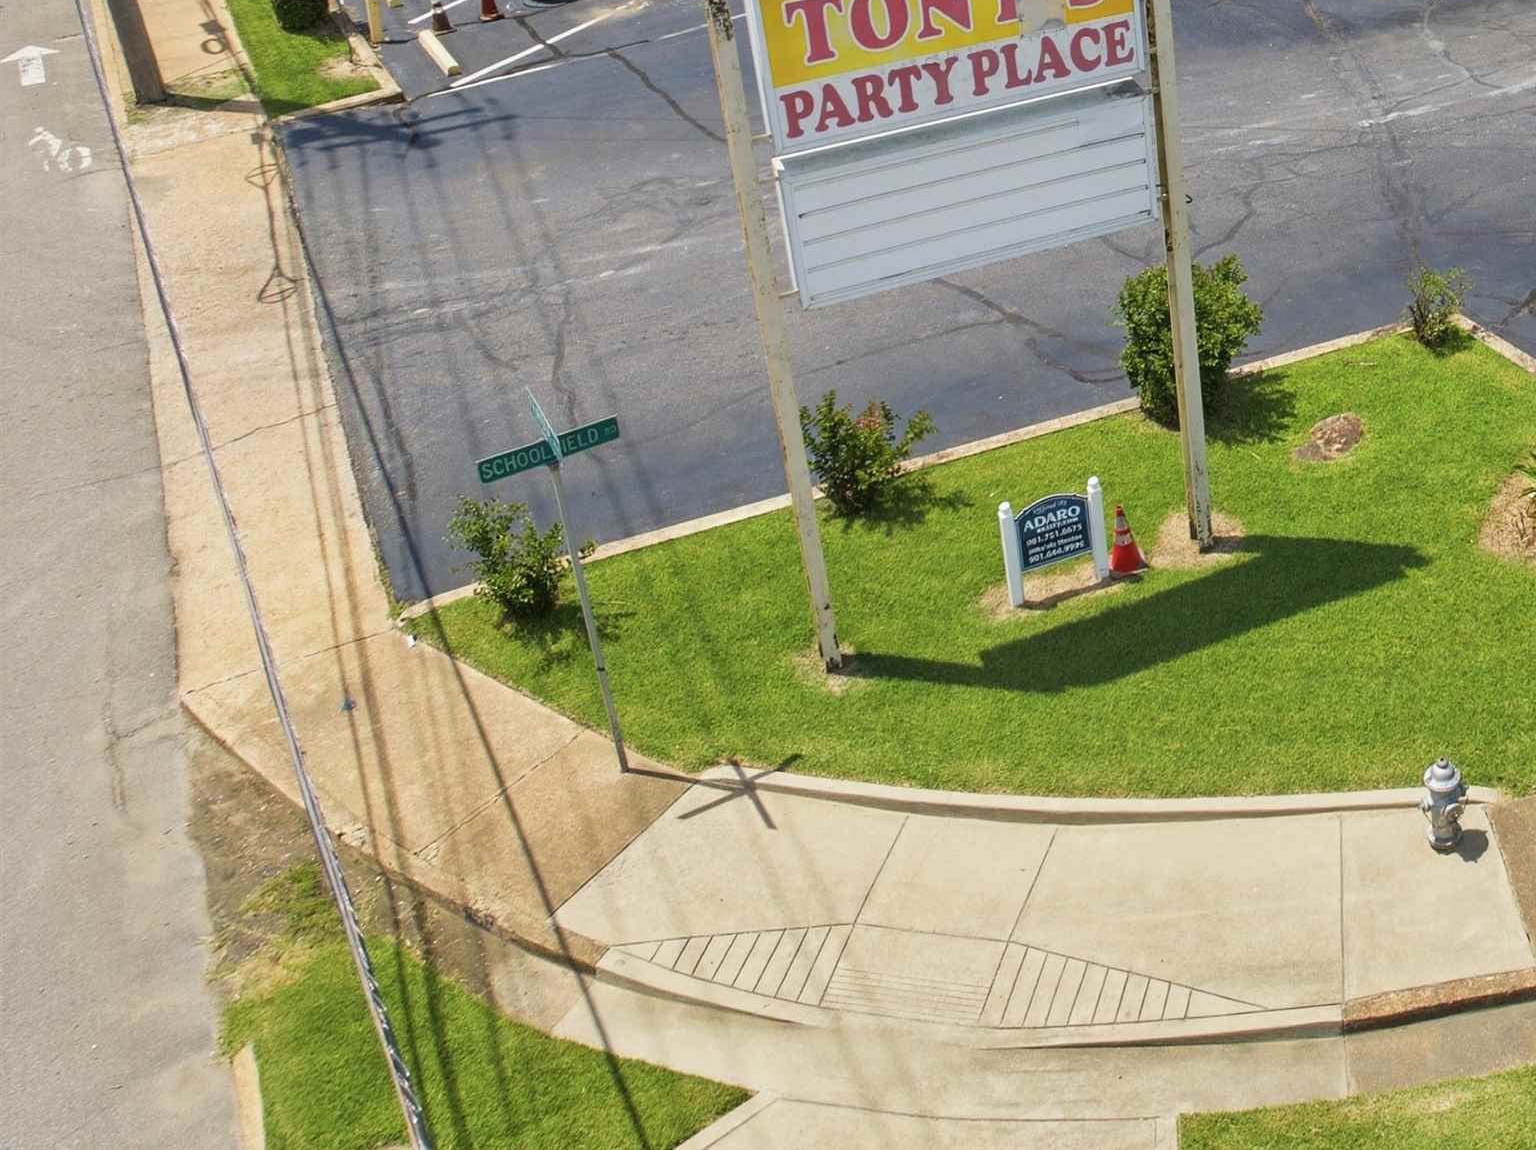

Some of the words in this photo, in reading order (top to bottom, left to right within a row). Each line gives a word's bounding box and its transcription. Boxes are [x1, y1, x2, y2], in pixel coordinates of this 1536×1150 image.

[779, 56, 959, 139] PARTY
[967, 20, 1135, 97] PLACE
[481, 427, 599, 479] SCHOOLIELD
[1023, 505, 1081, 533] ADARO
